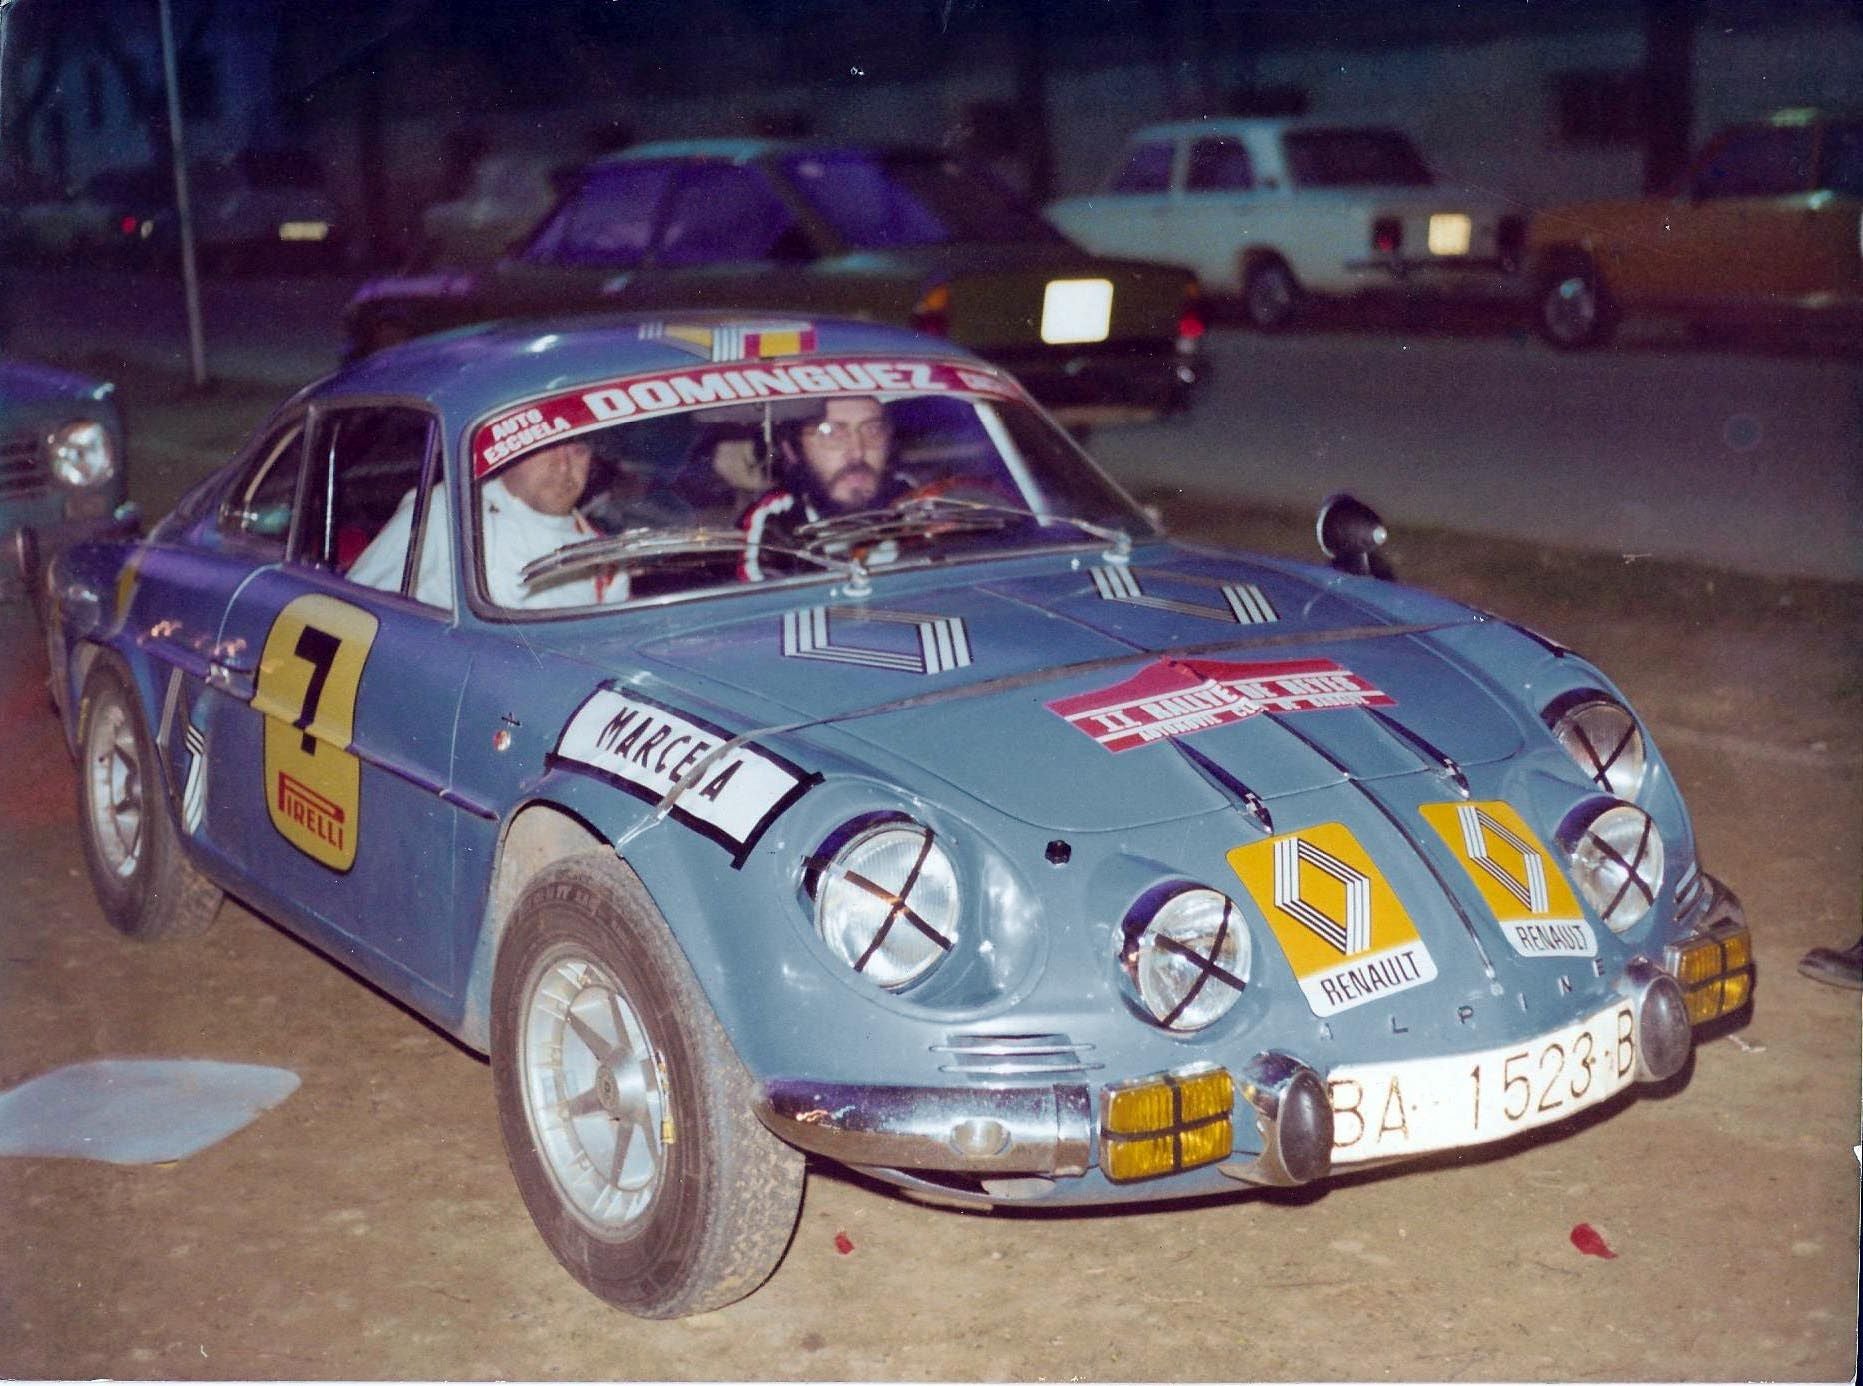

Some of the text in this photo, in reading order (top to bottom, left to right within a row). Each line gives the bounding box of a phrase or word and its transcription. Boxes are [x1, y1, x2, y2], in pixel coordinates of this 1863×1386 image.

[583, 363, 946, 422] DOMINGUEZ
[483, 417, 571, 465] ESCUELA
[491, 409, 543, 441] AUTO
[293, 624, 342, 757] 7
[1139, 684, 1238, 721] RALLYE
[597, 706, 744, 802] MARCEA
[278, 771, 345, 851] PIRELLI
[1514, 924, 1590, 951] RENAULT
[1320, 951, 1422, 1006] RENAULT
